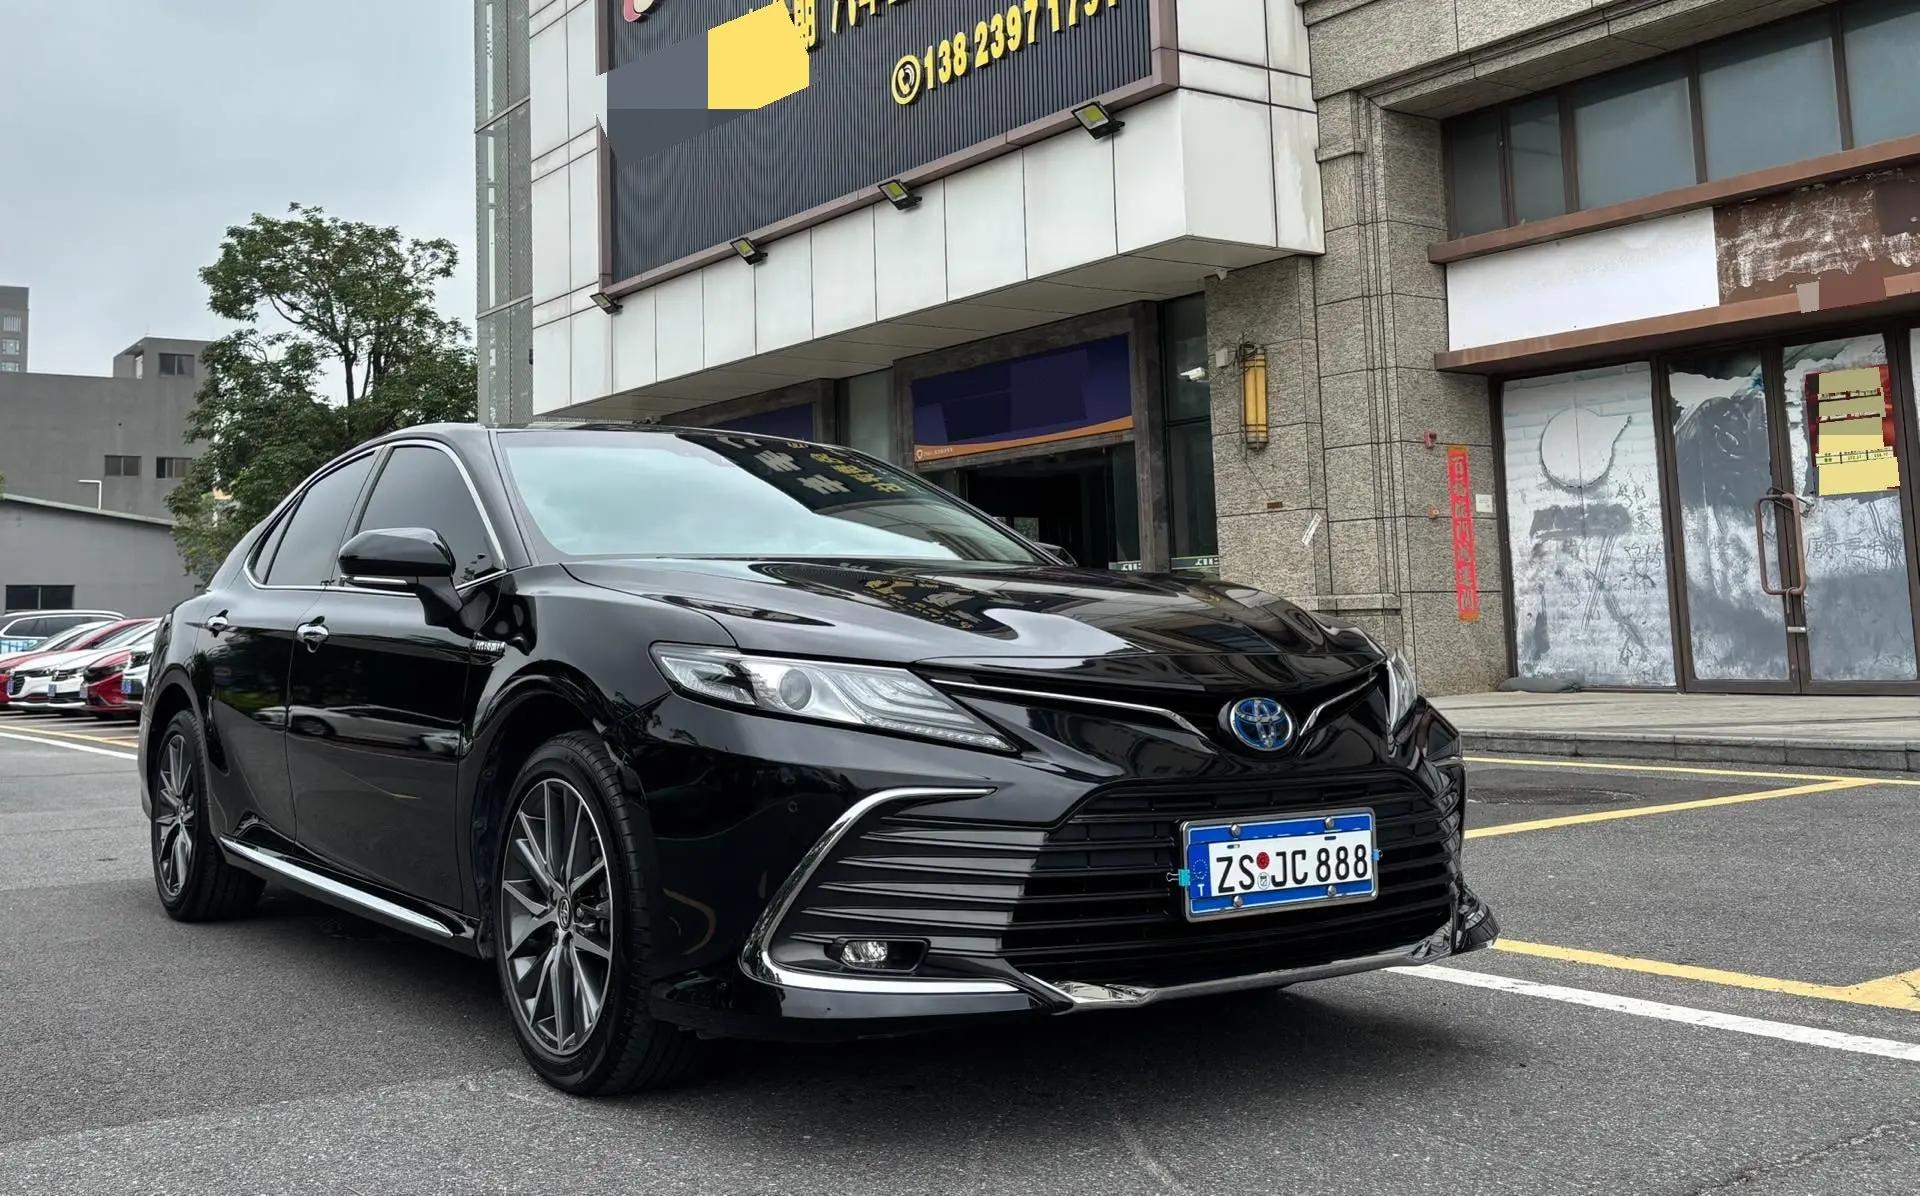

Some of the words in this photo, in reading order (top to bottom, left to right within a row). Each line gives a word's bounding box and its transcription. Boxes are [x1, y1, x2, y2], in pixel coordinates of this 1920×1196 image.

[924, 32, 967, 89] 138
[974, 0, 1038, 68] 2397
[1216, 855, 1255, 894] ZS
[1271, 849, 1308, 888] JC
[1316, 844, 1368, 883] 888
